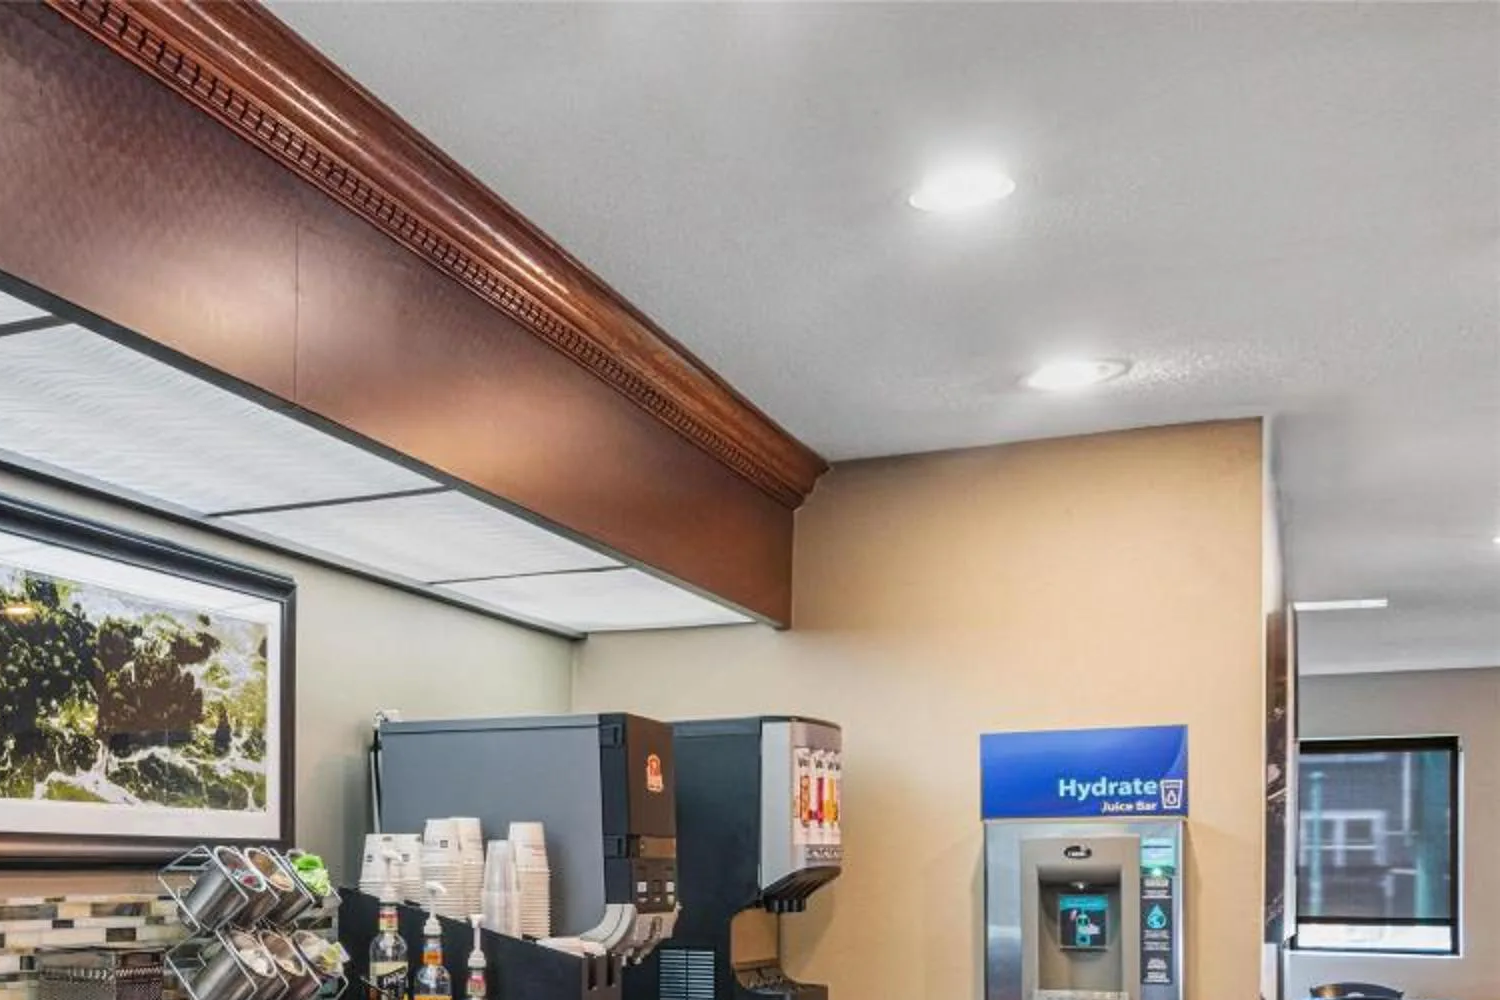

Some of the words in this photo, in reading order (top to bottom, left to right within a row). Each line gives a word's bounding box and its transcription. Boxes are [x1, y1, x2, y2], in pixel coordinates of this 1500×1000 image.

[1059, 776, 1158, 801] Hydrate
[1101, 801, 1134, 813] Juice
[1135, 801, 1158, 811] Bar
